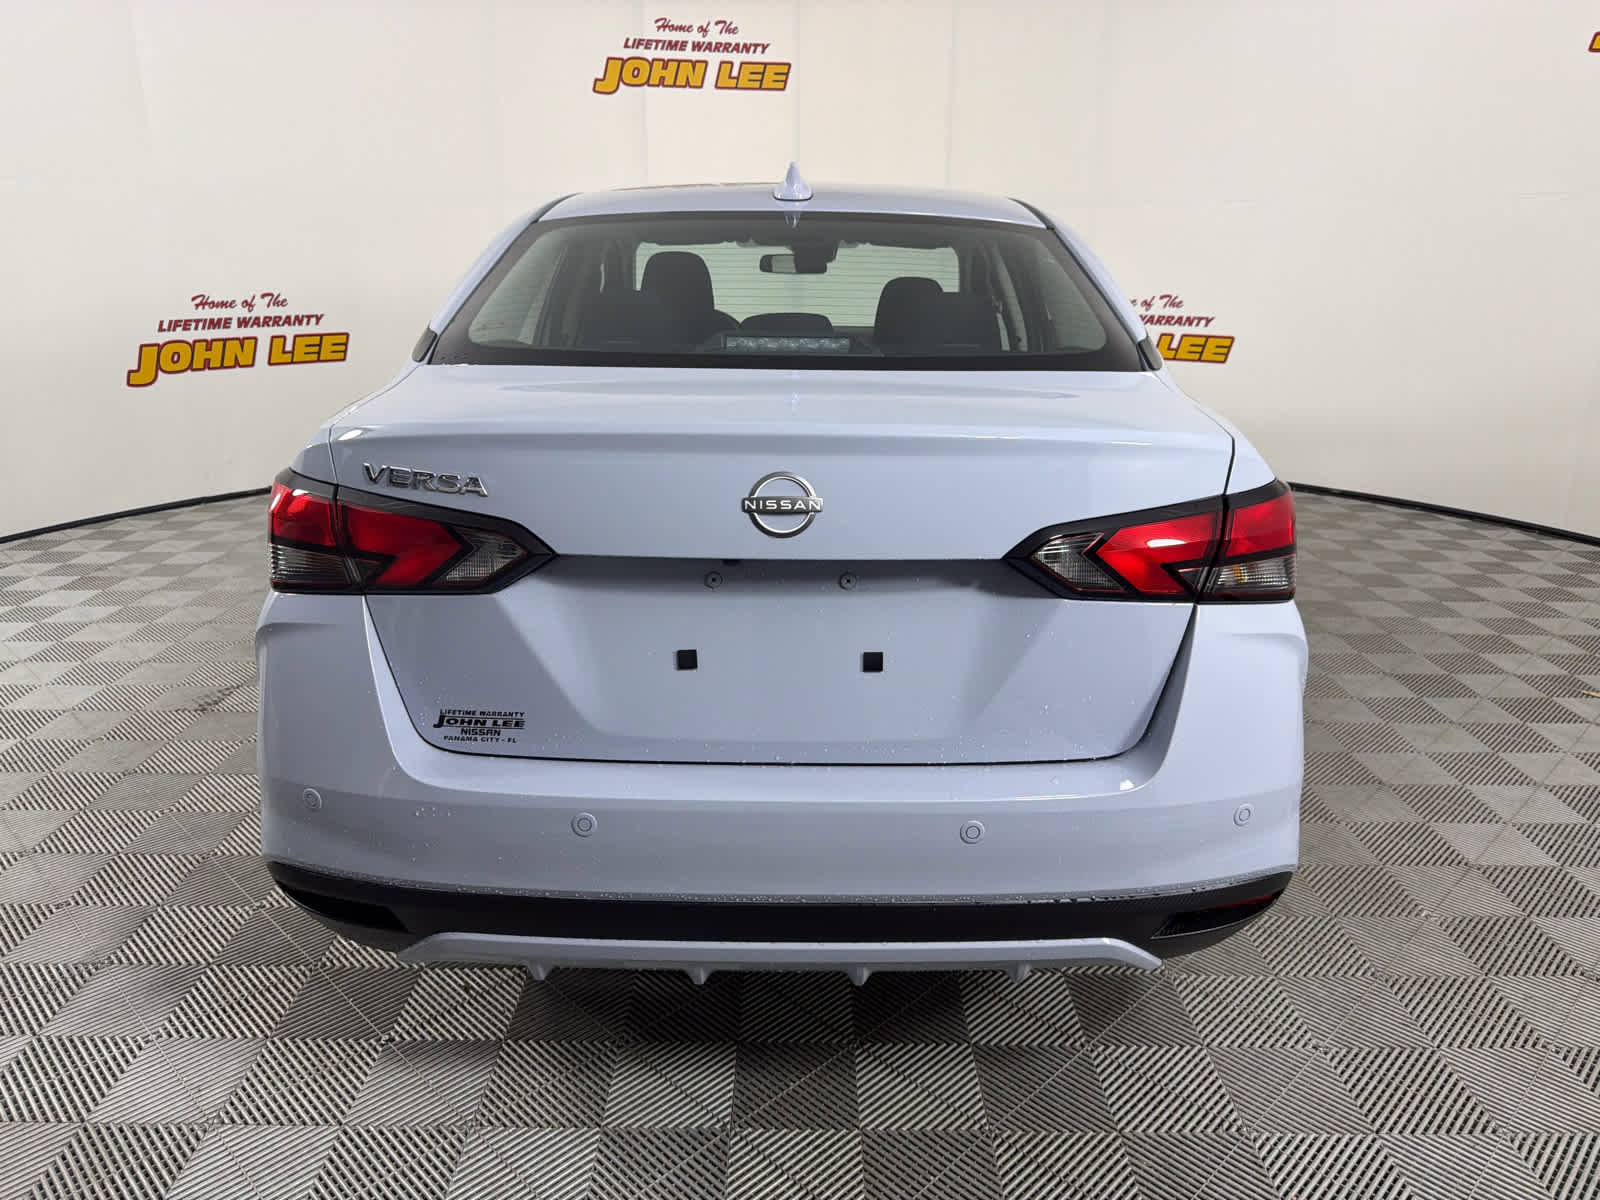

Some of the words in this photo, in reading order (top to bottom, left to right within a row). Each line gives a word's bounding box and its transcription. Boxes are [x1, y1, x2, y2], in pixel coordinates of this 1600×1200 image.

[654, 17, 694, 33] Home
[697, 21, 710, 37] of
[715, 20, 739, 35] The
[623, 38, 688, 51] LIFETIME
[691, 41, 770, 54] WARRANTY
[592, 57, 708, 95] JOHN
[714, 61, 791, 91] LEE
[191, 294, 237, 310] Home
[241, 296, 256, 312] of
[260, 293, 288, 308] The
[1140, 296, 1155, 311] of
[1159, 294, 1184, 309] The
[157, 317, 232, 333] LIFETIME
[236, 314, 323, 329] WARRANTY
[1156, 333, 1235, 363] LEE
[126, 336, 258, 388] JOHN
[267, 332, 350, 366] LEE
[363, 462, 488, 497] VERSA
[744, 499, 821, 510] NISSAN
[433, 715, 487, 728] JOHN
[492, 719, 526, 728] LEE
[461, 728, 501, 736] NISSAN
